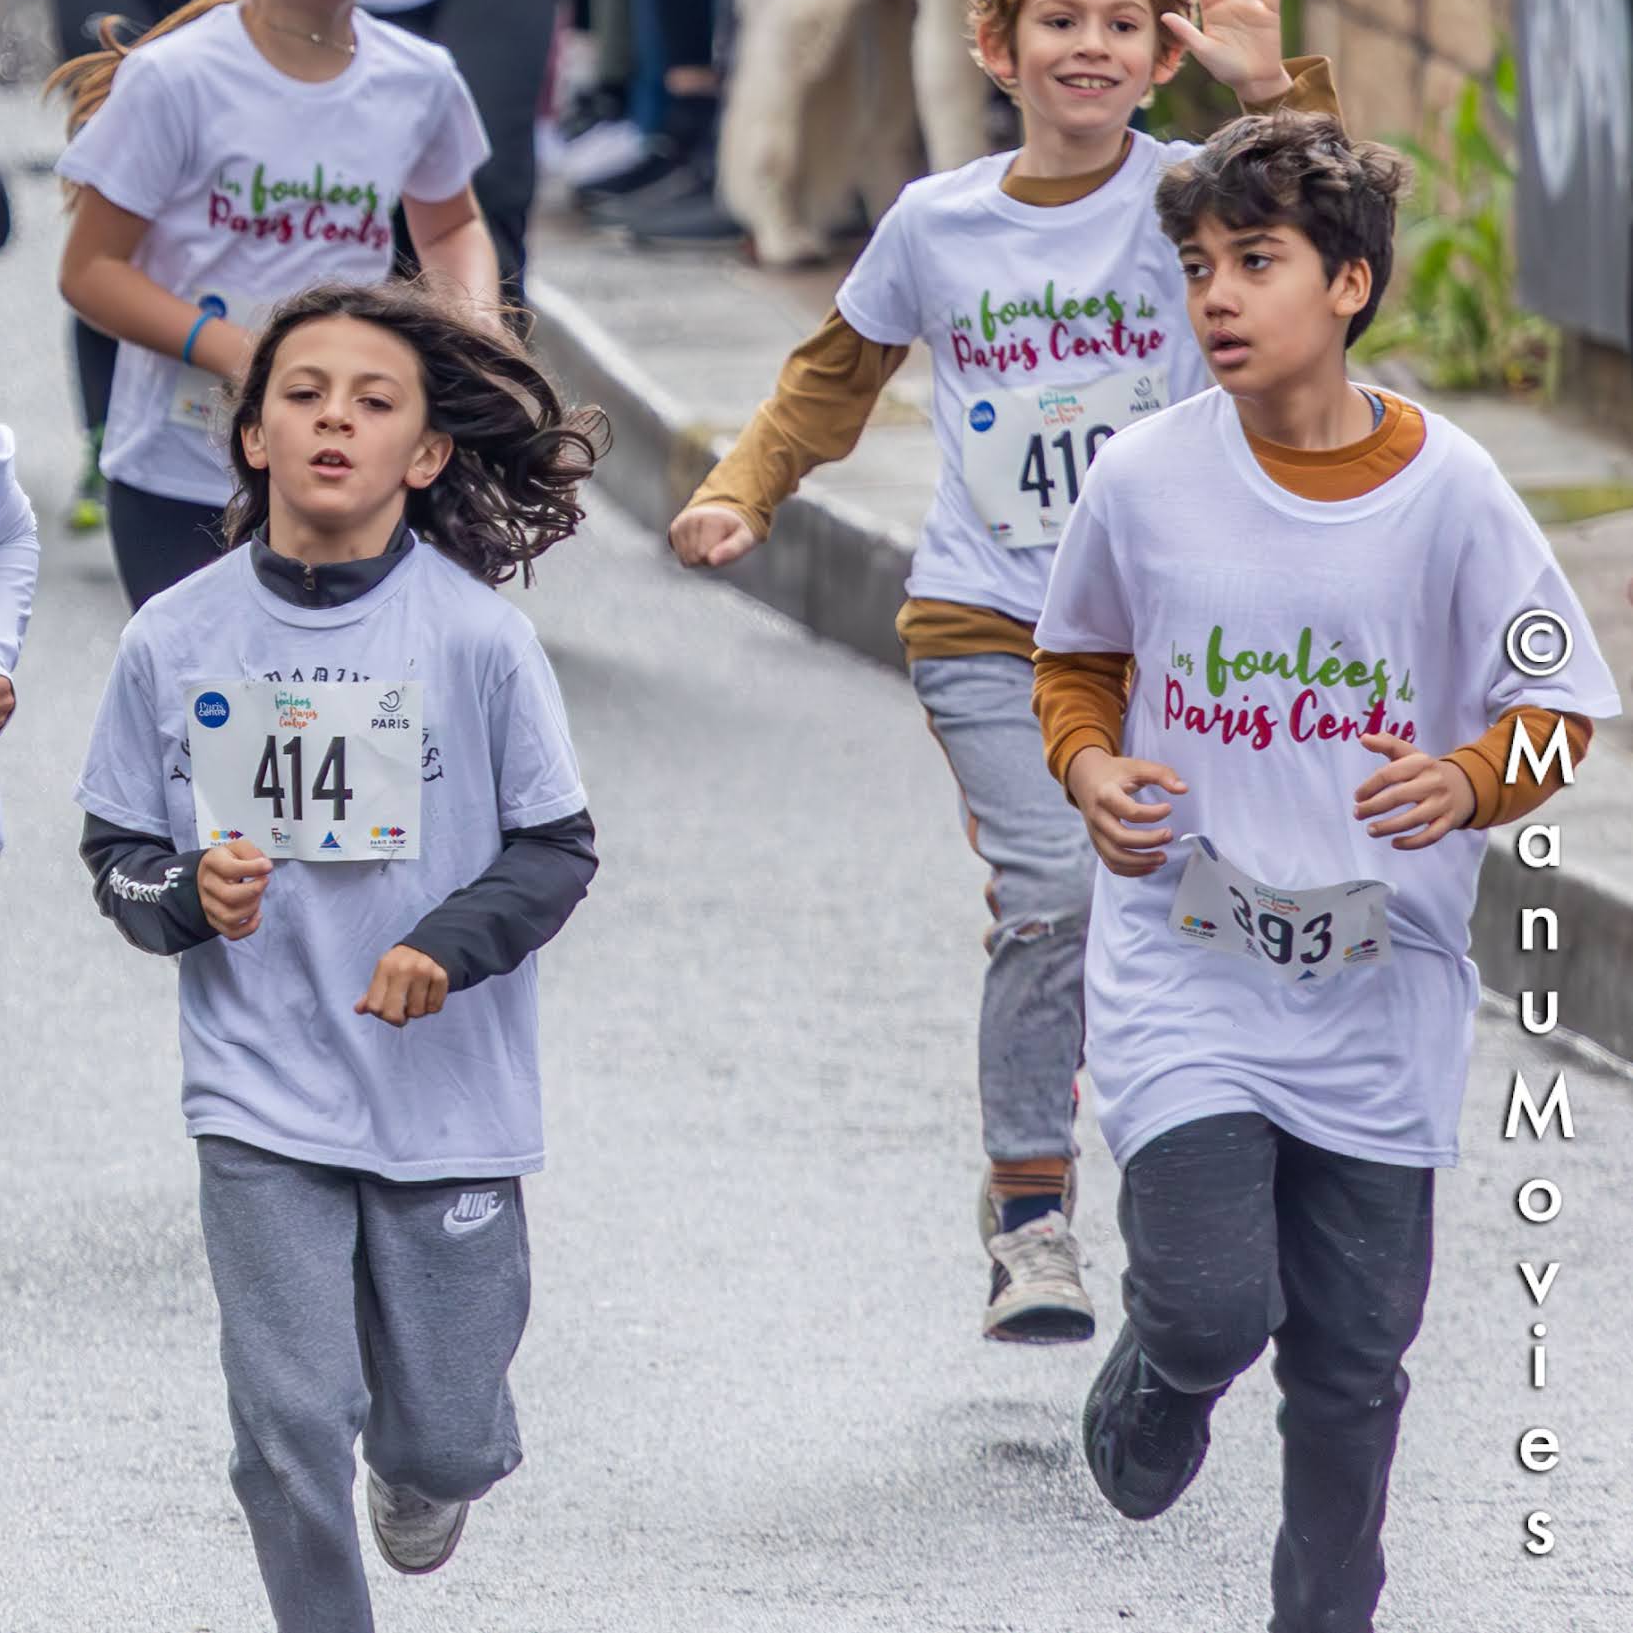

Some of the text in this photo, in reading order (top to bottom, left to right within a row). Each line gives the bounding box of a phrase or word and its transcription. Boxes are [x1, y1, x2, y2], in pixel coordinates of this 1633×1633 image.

[980, 279, 1129, 342] foulées
[951, 321, 1165, 373] Paris Centre
[1206, 625, 1391, 708] foulées
[371, 718, 411, 730] PARIS
[1164, 673, 1279, 751] Paris
[253, 735, 352, 820] 414
[1229, 885, 1333, 965] 393
[454, 1191, 498, 1218] NIKE
